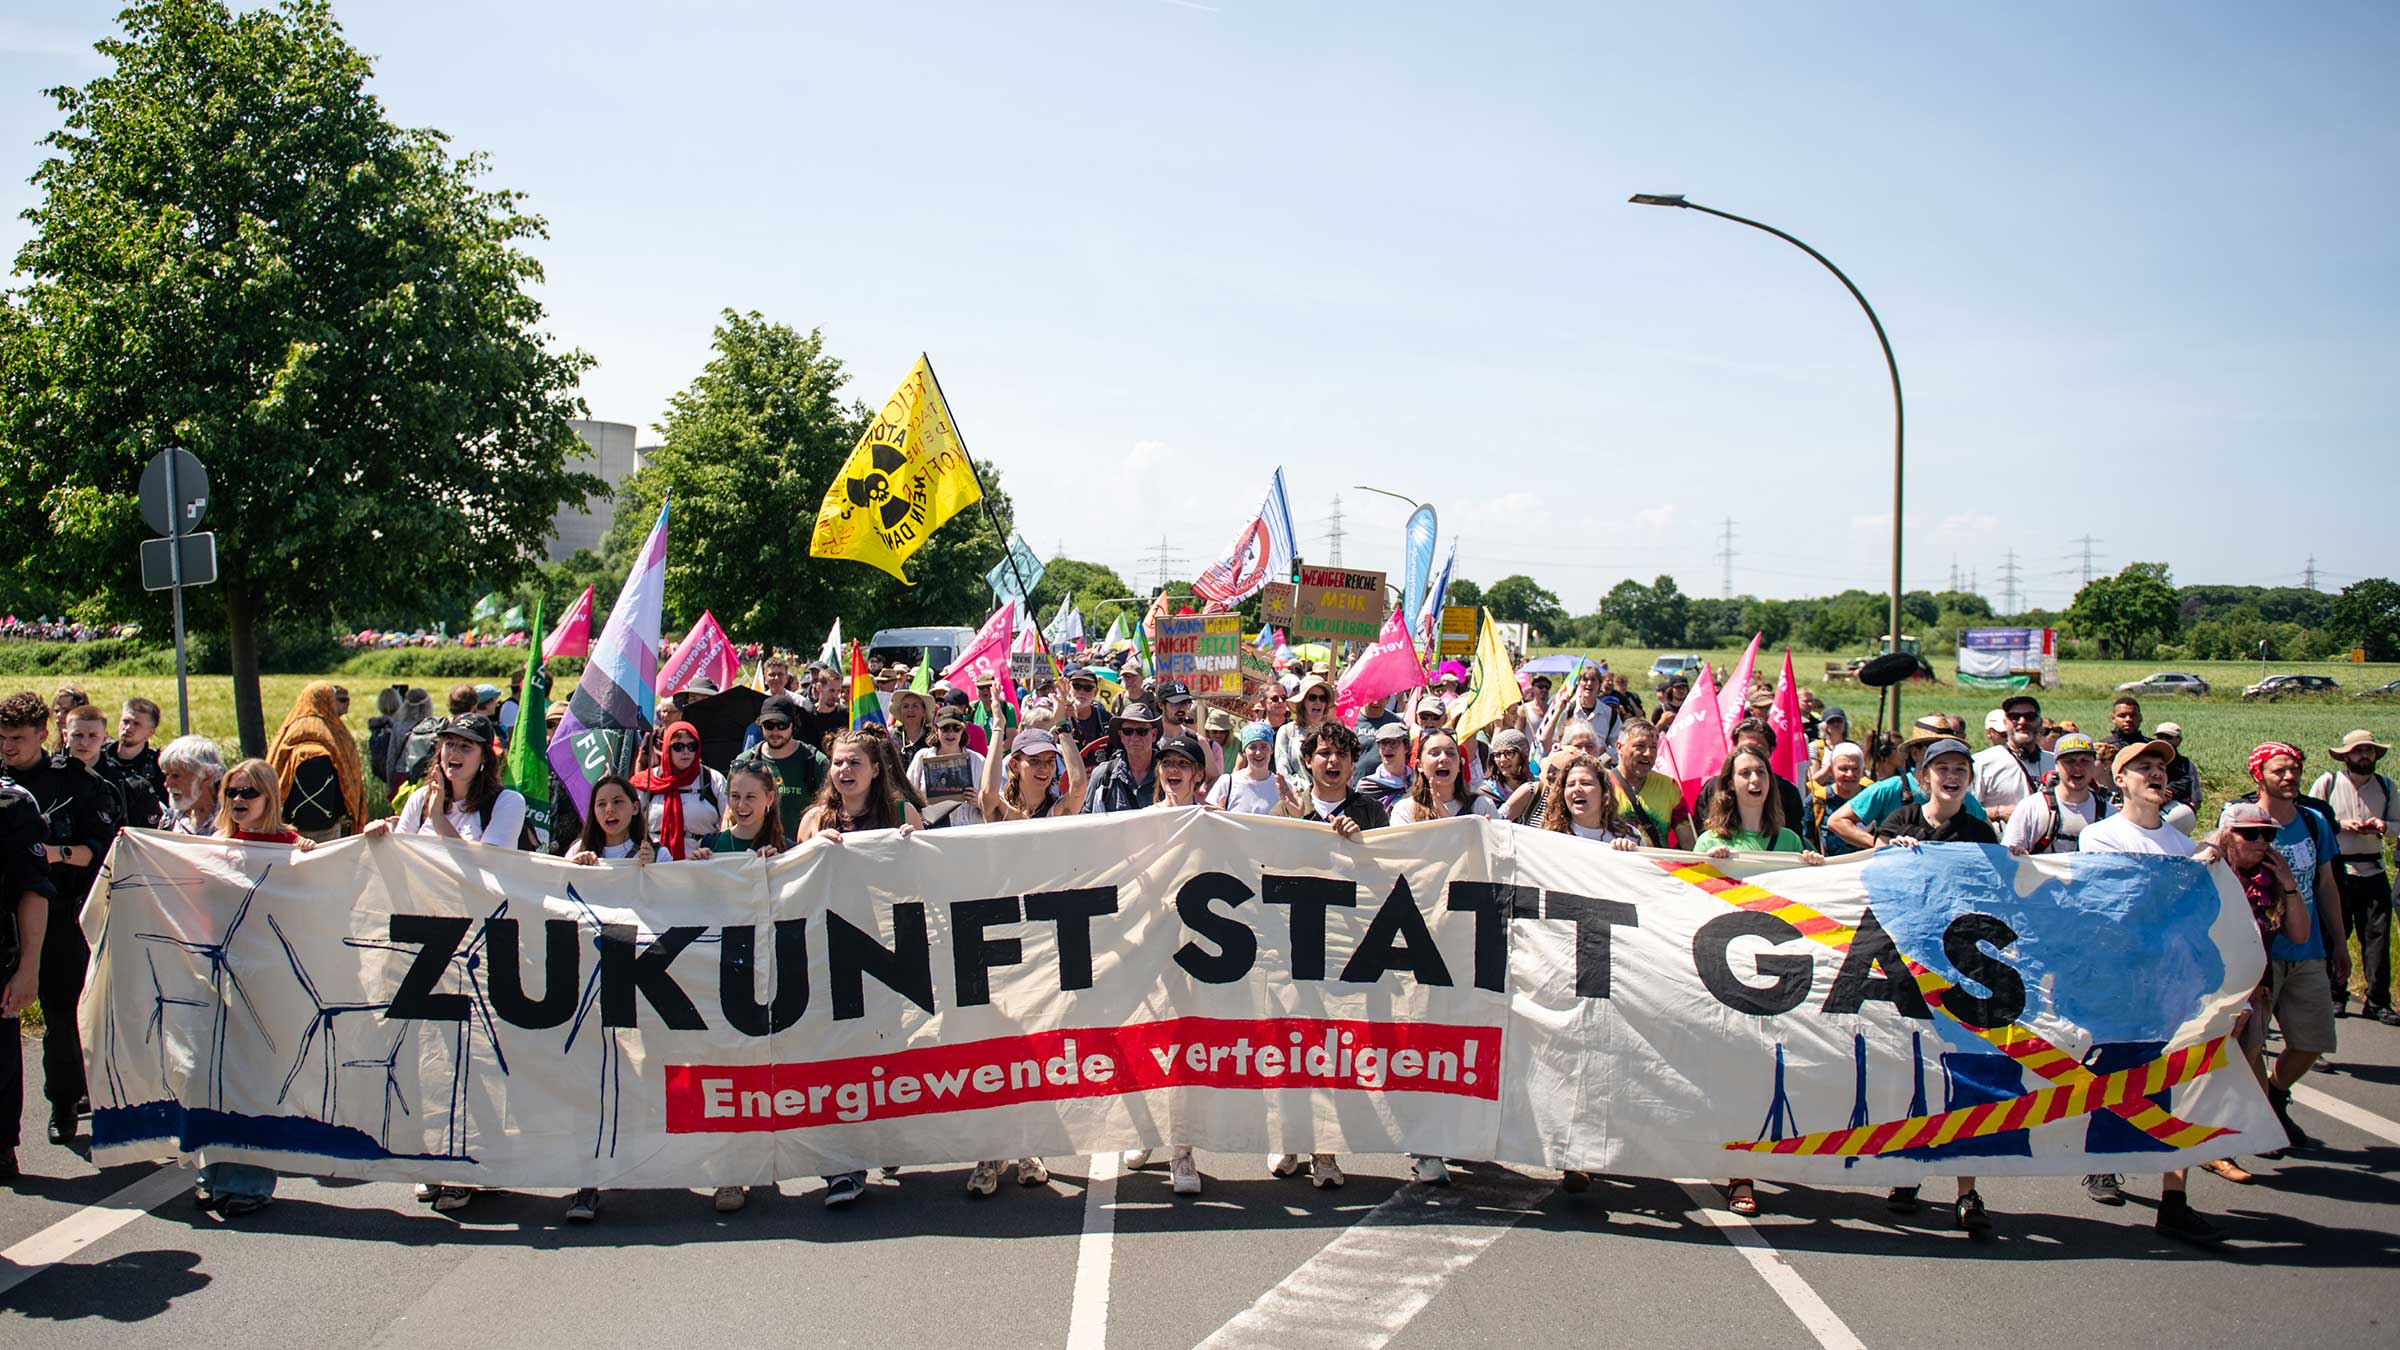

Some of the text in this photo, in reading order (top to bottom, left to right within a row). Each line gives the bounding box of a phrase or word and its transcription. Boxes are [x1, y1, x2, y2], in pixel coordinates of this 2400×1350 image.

[1344, 573, 1377, 591] REICHE
[1320, 591, 1366, 611] MEHR
[1161, 617, 1239, 636] WANN WENN
[1158, 635, 1238, 655] NICHT JETZT
[1158, 654, 1195, 673] WER
[1194, 655, 1238, 672] WENN
[1200, 673, 1220, 692] DU
[384, 871, 2027, 1037] ZUKUNFT STATT GAS
[701, 1028, 1480, 1122] Energiewende verteidigen!
